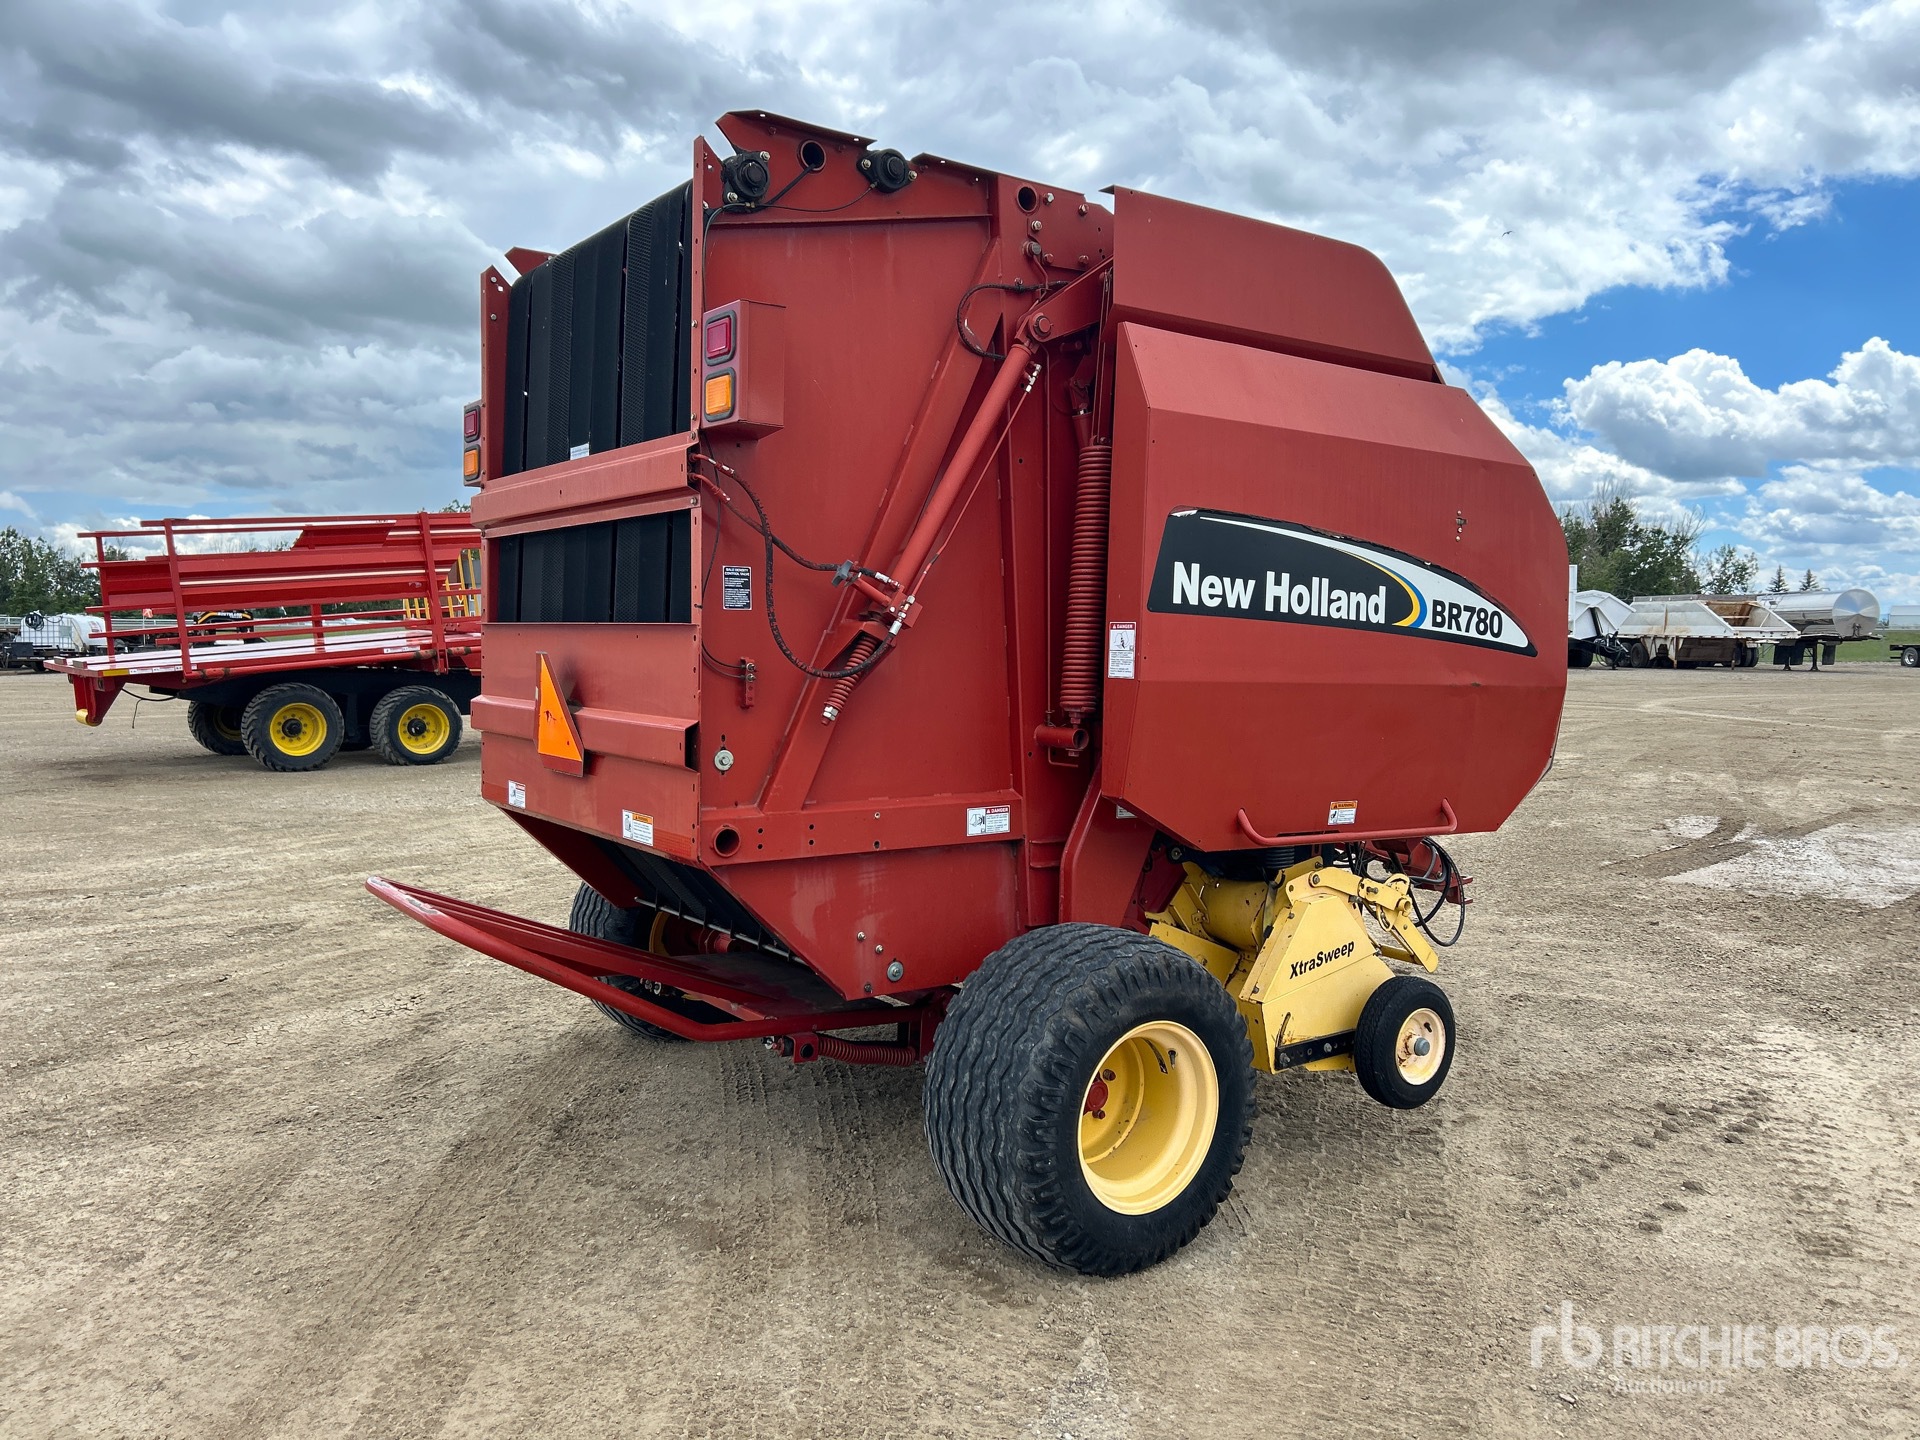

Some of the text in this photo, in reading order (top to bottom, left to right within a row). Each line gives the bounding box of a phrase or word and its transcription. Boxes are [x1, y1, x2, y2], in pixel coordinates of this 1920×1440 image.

[1172, 561, 1386, 624] New Holland
[1431, 600, 1503, 638] BR780
[1289, 940, 1355, 979] XtraSweep
